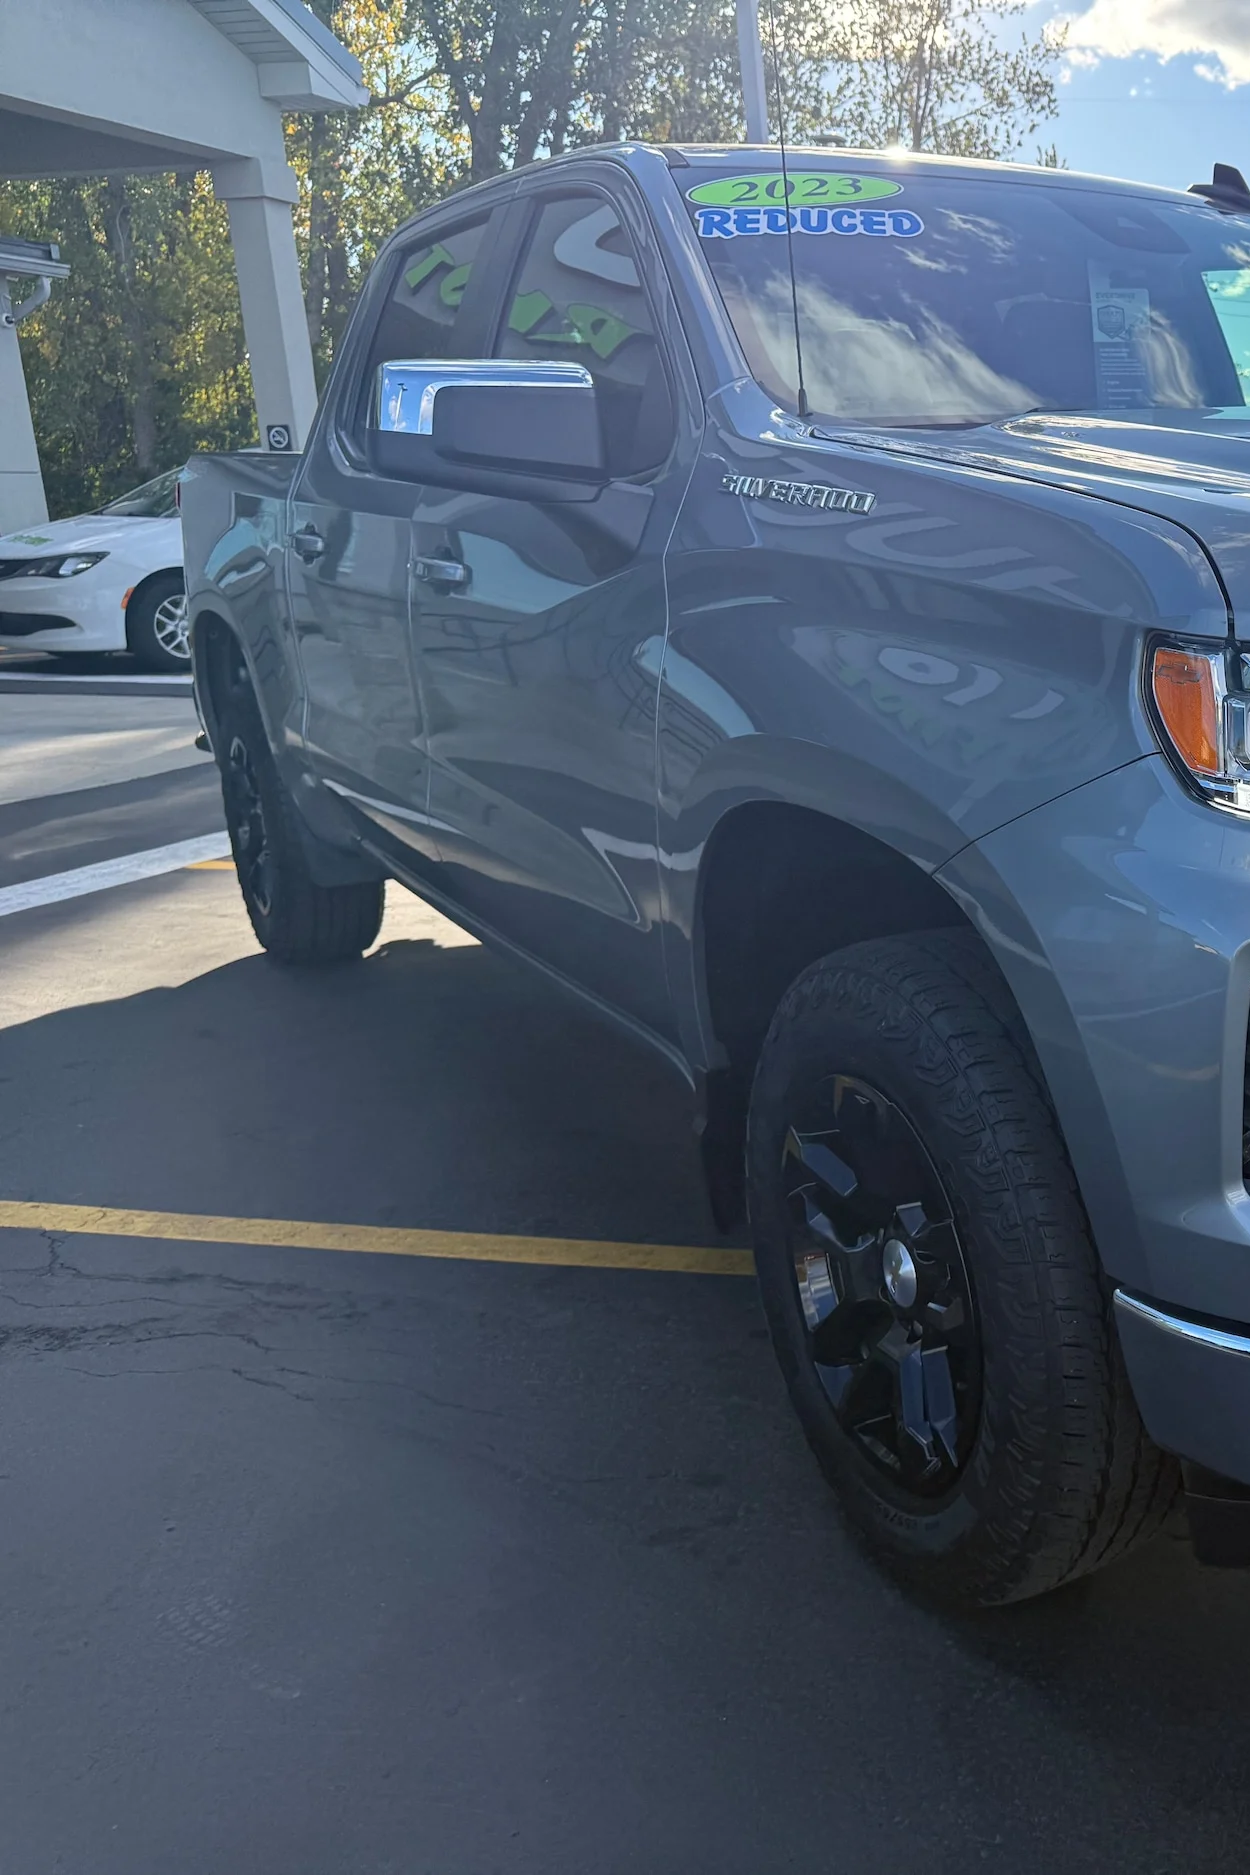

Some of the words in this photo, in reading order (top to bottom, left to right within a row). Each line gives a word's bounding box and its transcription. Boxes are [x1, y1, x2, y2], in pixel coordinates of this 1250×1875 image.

[730, 177, 863, 203] 2023
[697, 208, 922, 237] REDUCED
[723, 474, 877, 515] SILVERADO
